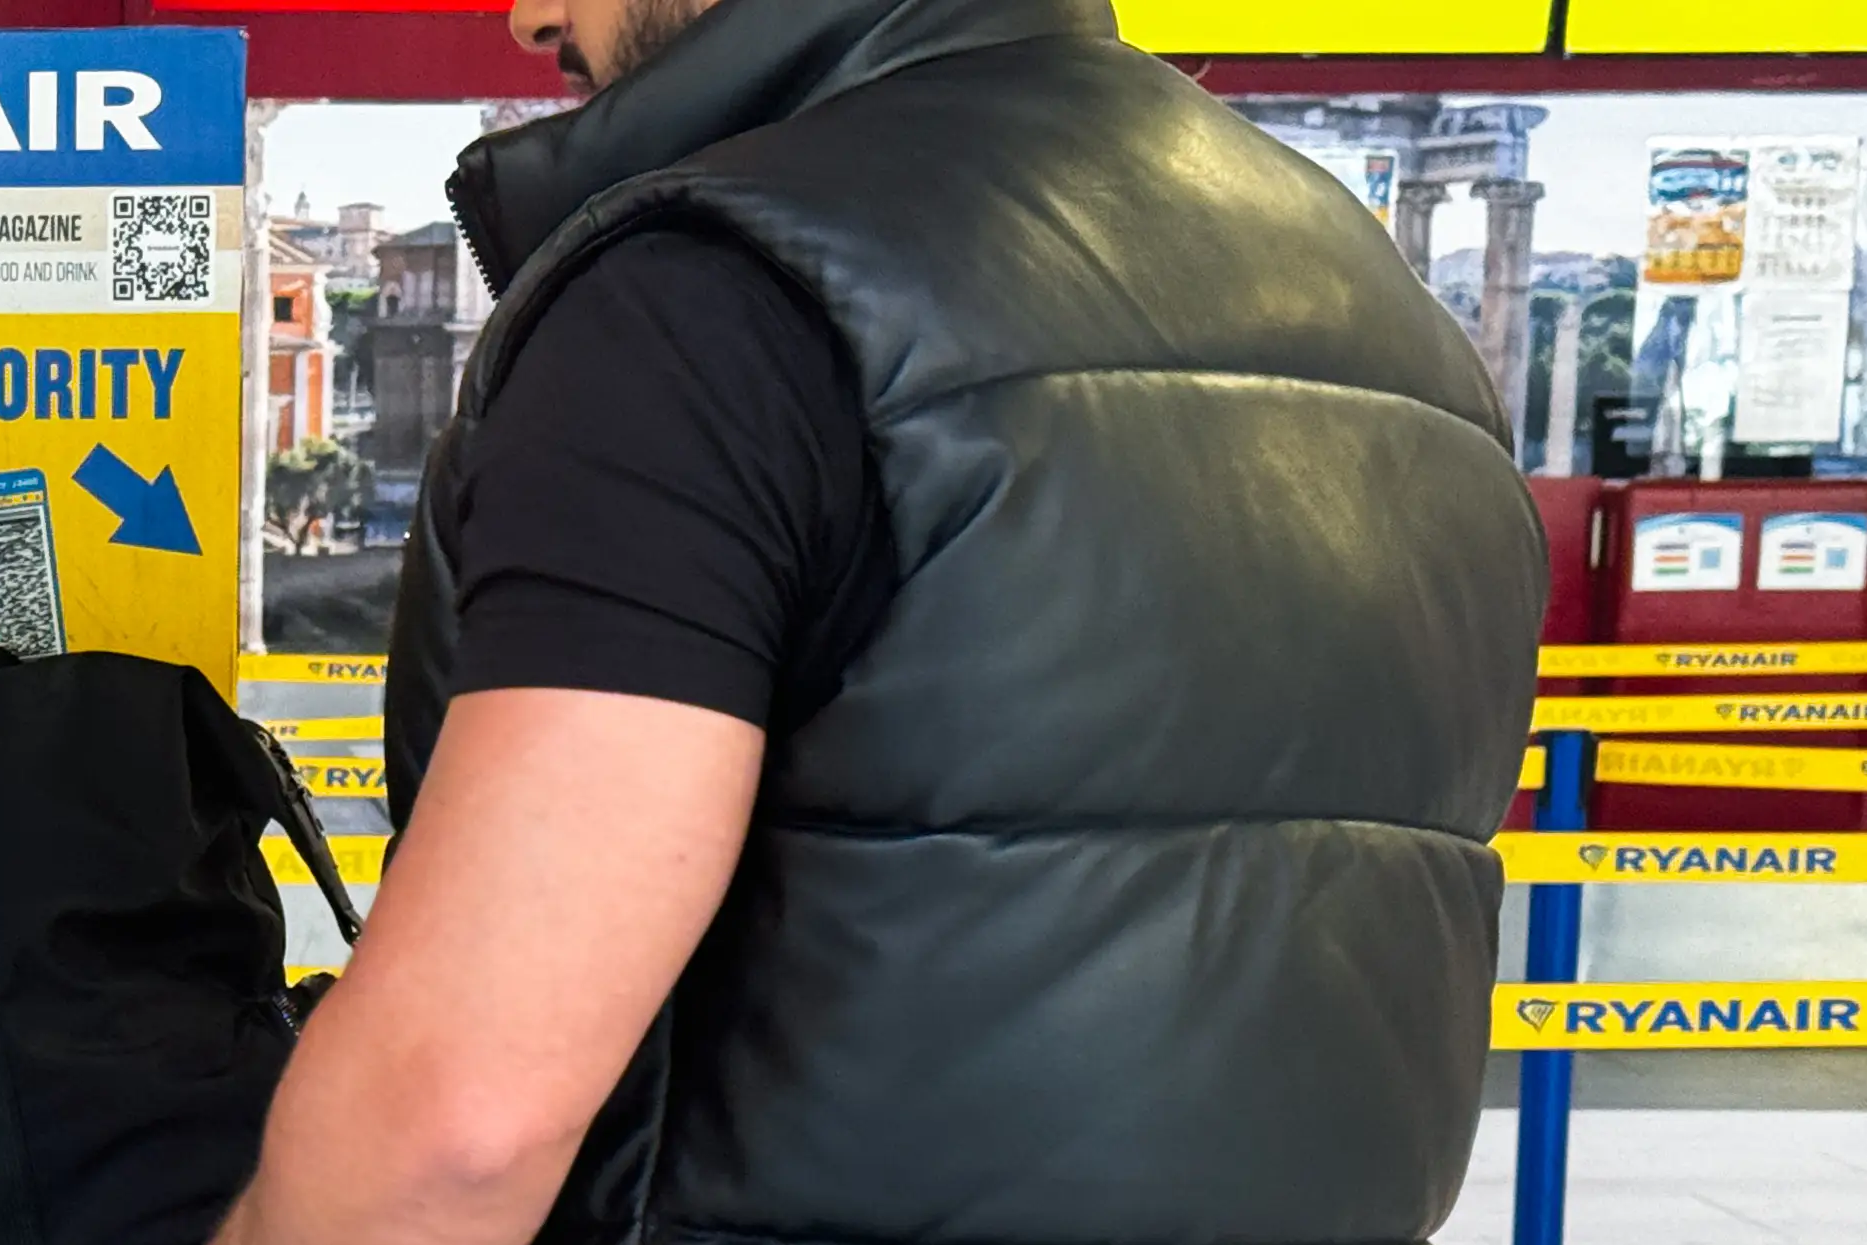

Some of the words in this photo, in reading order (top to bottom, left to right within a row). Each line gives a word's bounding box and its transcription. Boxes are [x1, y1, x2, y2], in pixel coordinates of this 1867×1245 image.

[23, 261, 51, 281] AND
[57, 261, 98, 281] DRINK
[1676, 652, 1798, 667] RYANAIR
[1739, 703, 1867, 721] RYANAI
[1615, 846, 1837, 875] RYANAIR
[1564, 998, 1861, 1034] RYANAIR
